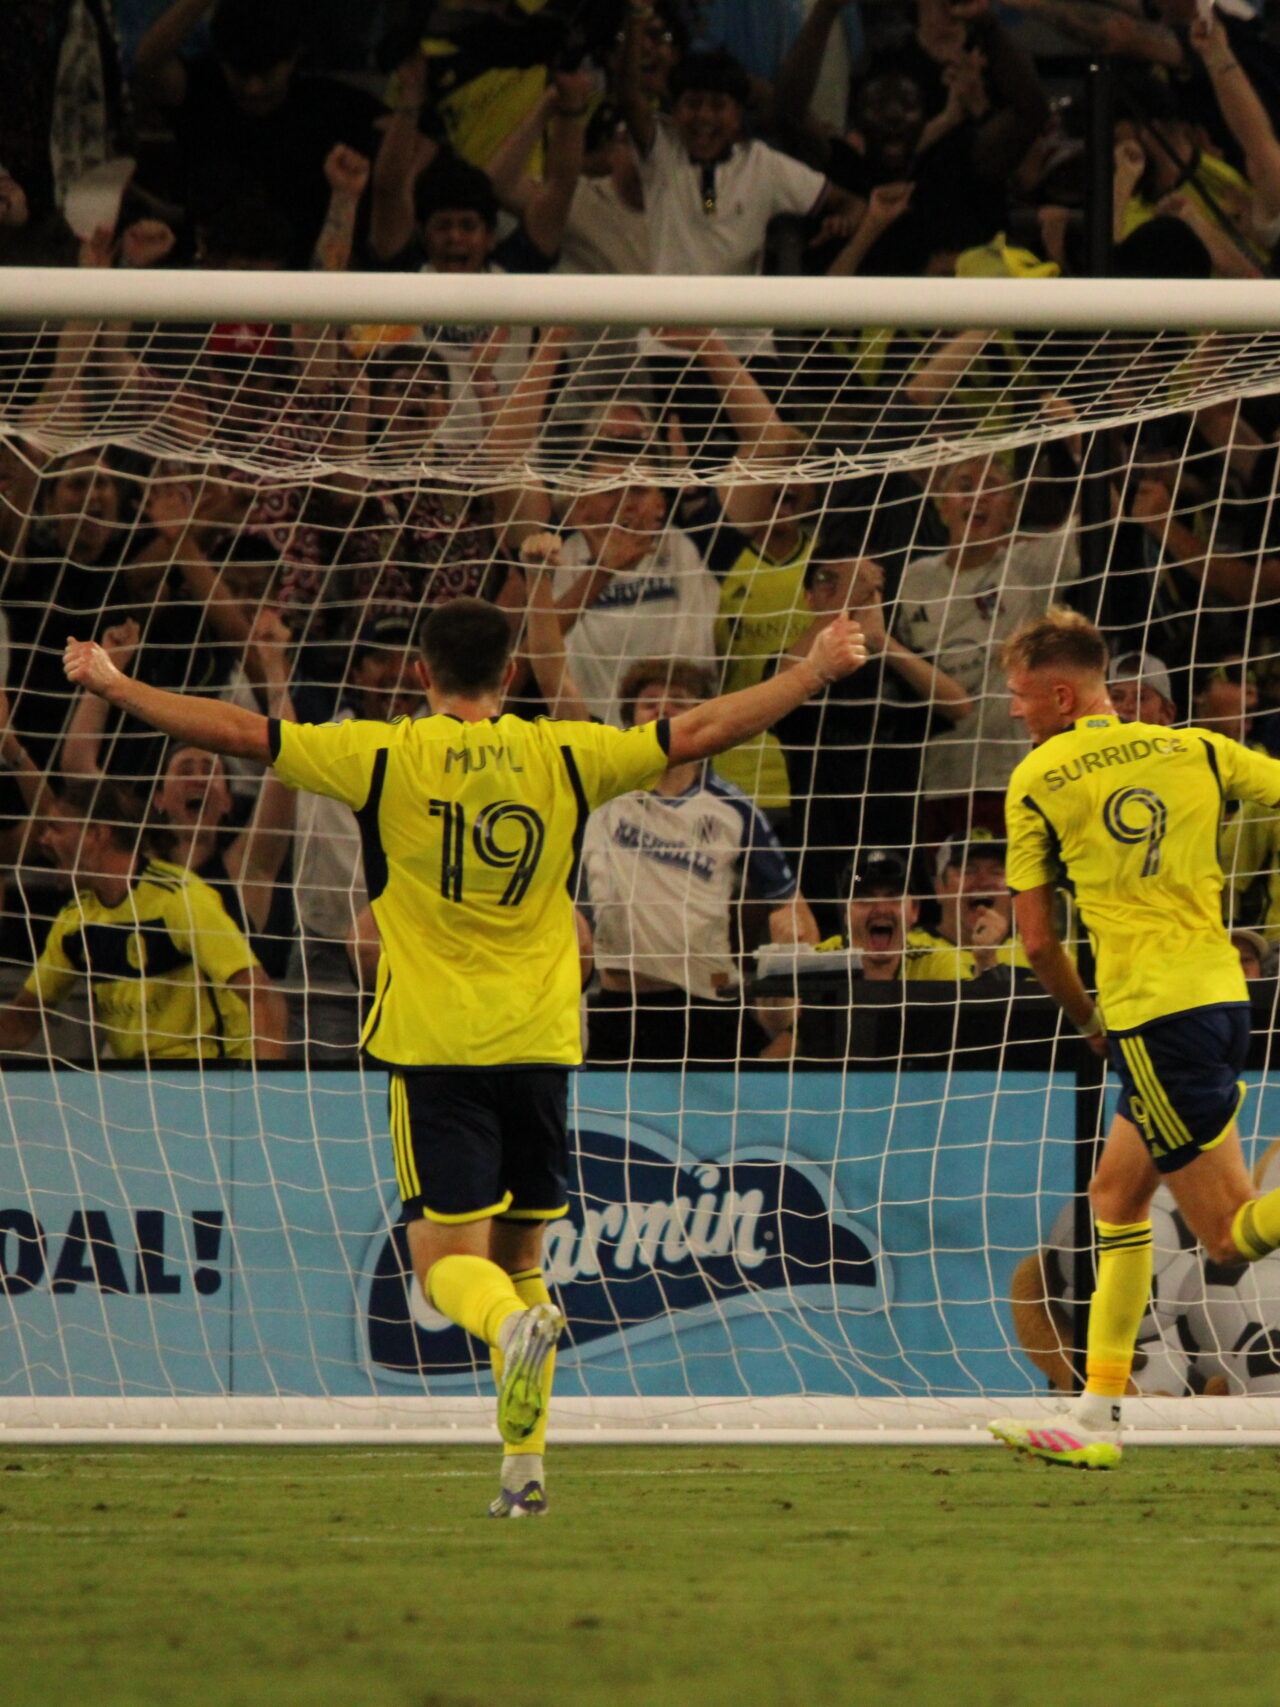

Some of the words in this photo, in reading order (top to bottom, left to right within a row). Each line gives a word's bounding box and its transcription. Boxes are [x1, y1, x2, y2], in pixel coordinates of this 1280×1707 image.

[444, 745, 524, 774] MUYL
[1043, 737, 1188, 792] SURRIDGE
[429, 798, 545, 906] 19
[1103, 785, 1167, 878] 9
[1129, 1096, 1156, 1140] 9
